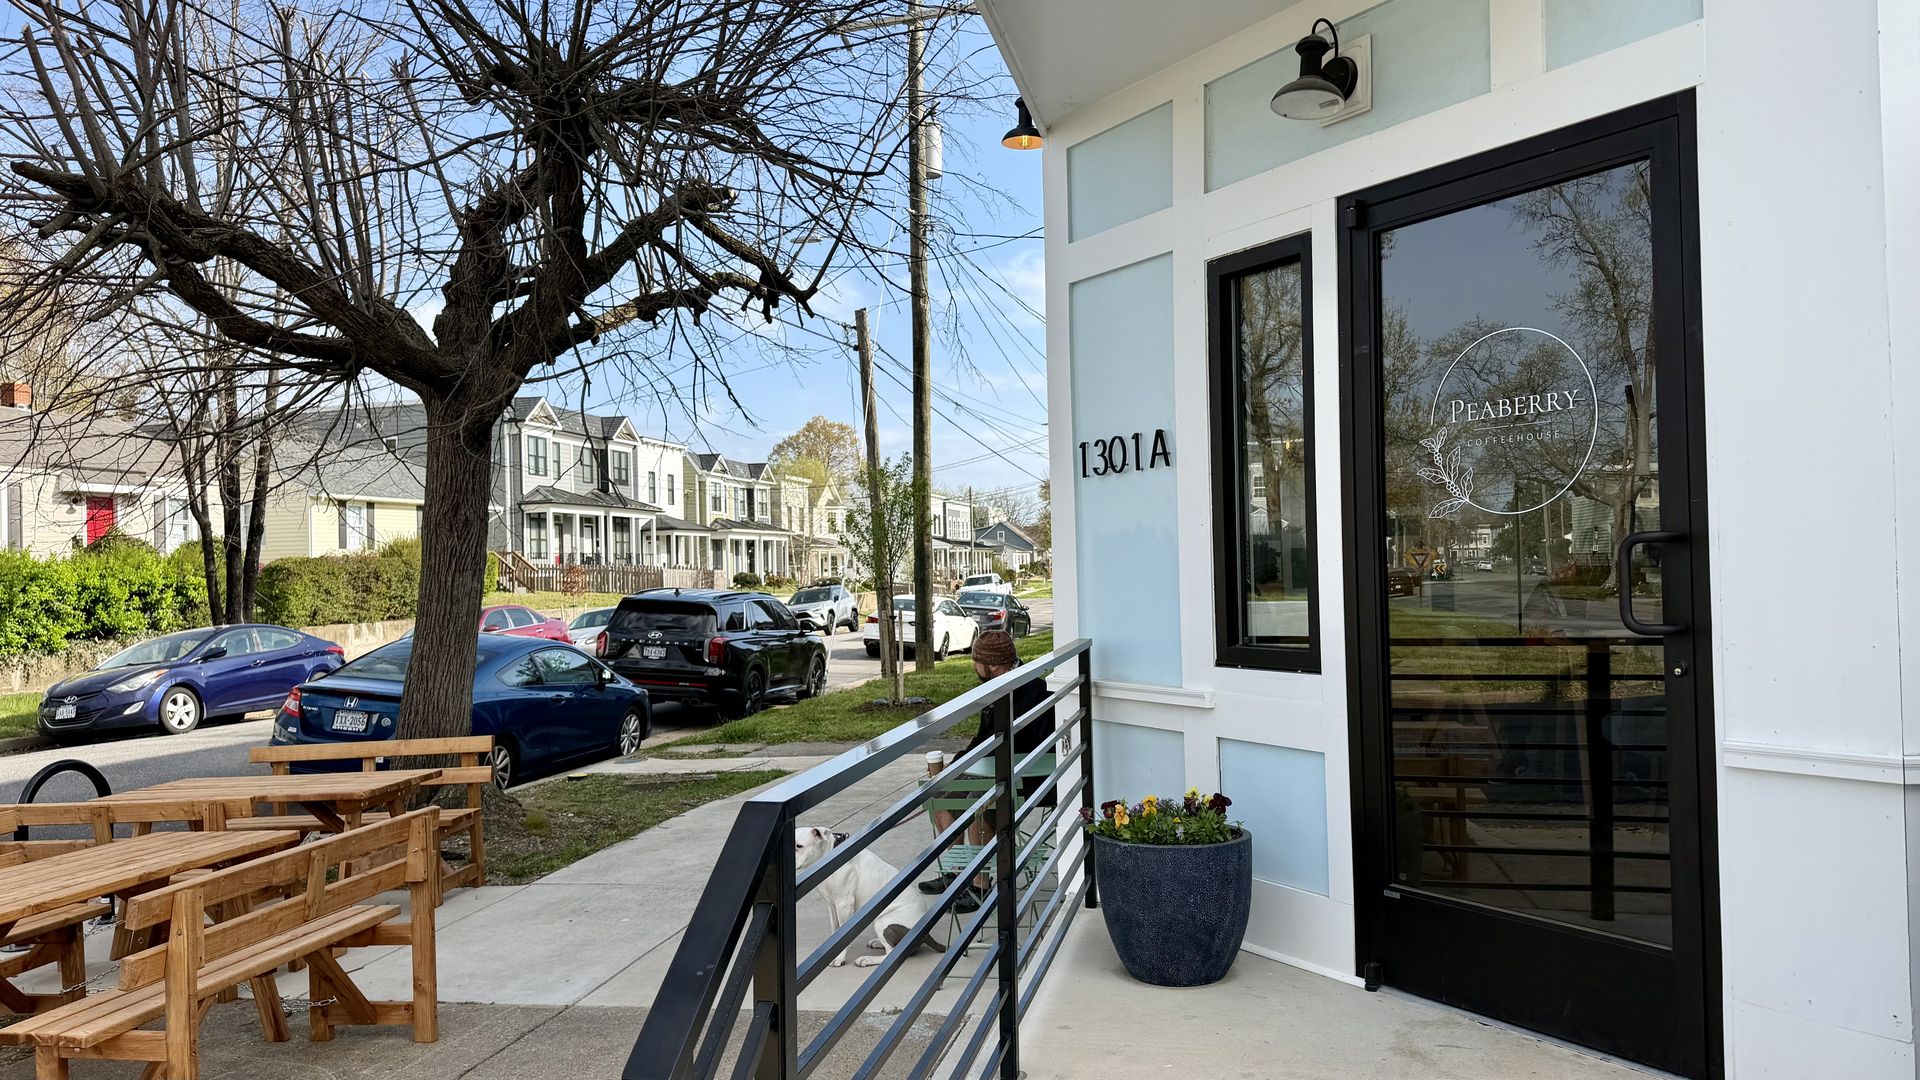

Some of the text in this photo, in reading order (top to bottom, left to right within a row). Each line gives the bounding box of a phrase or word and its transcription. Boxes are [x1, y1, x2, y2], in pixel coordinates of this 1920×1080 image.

[1450, 389, 1585, 423] PEABERRY
[1079, 429, 1170, 478] 1301A
[1467, 430, 1560, 447] COFFEEHOUSE
